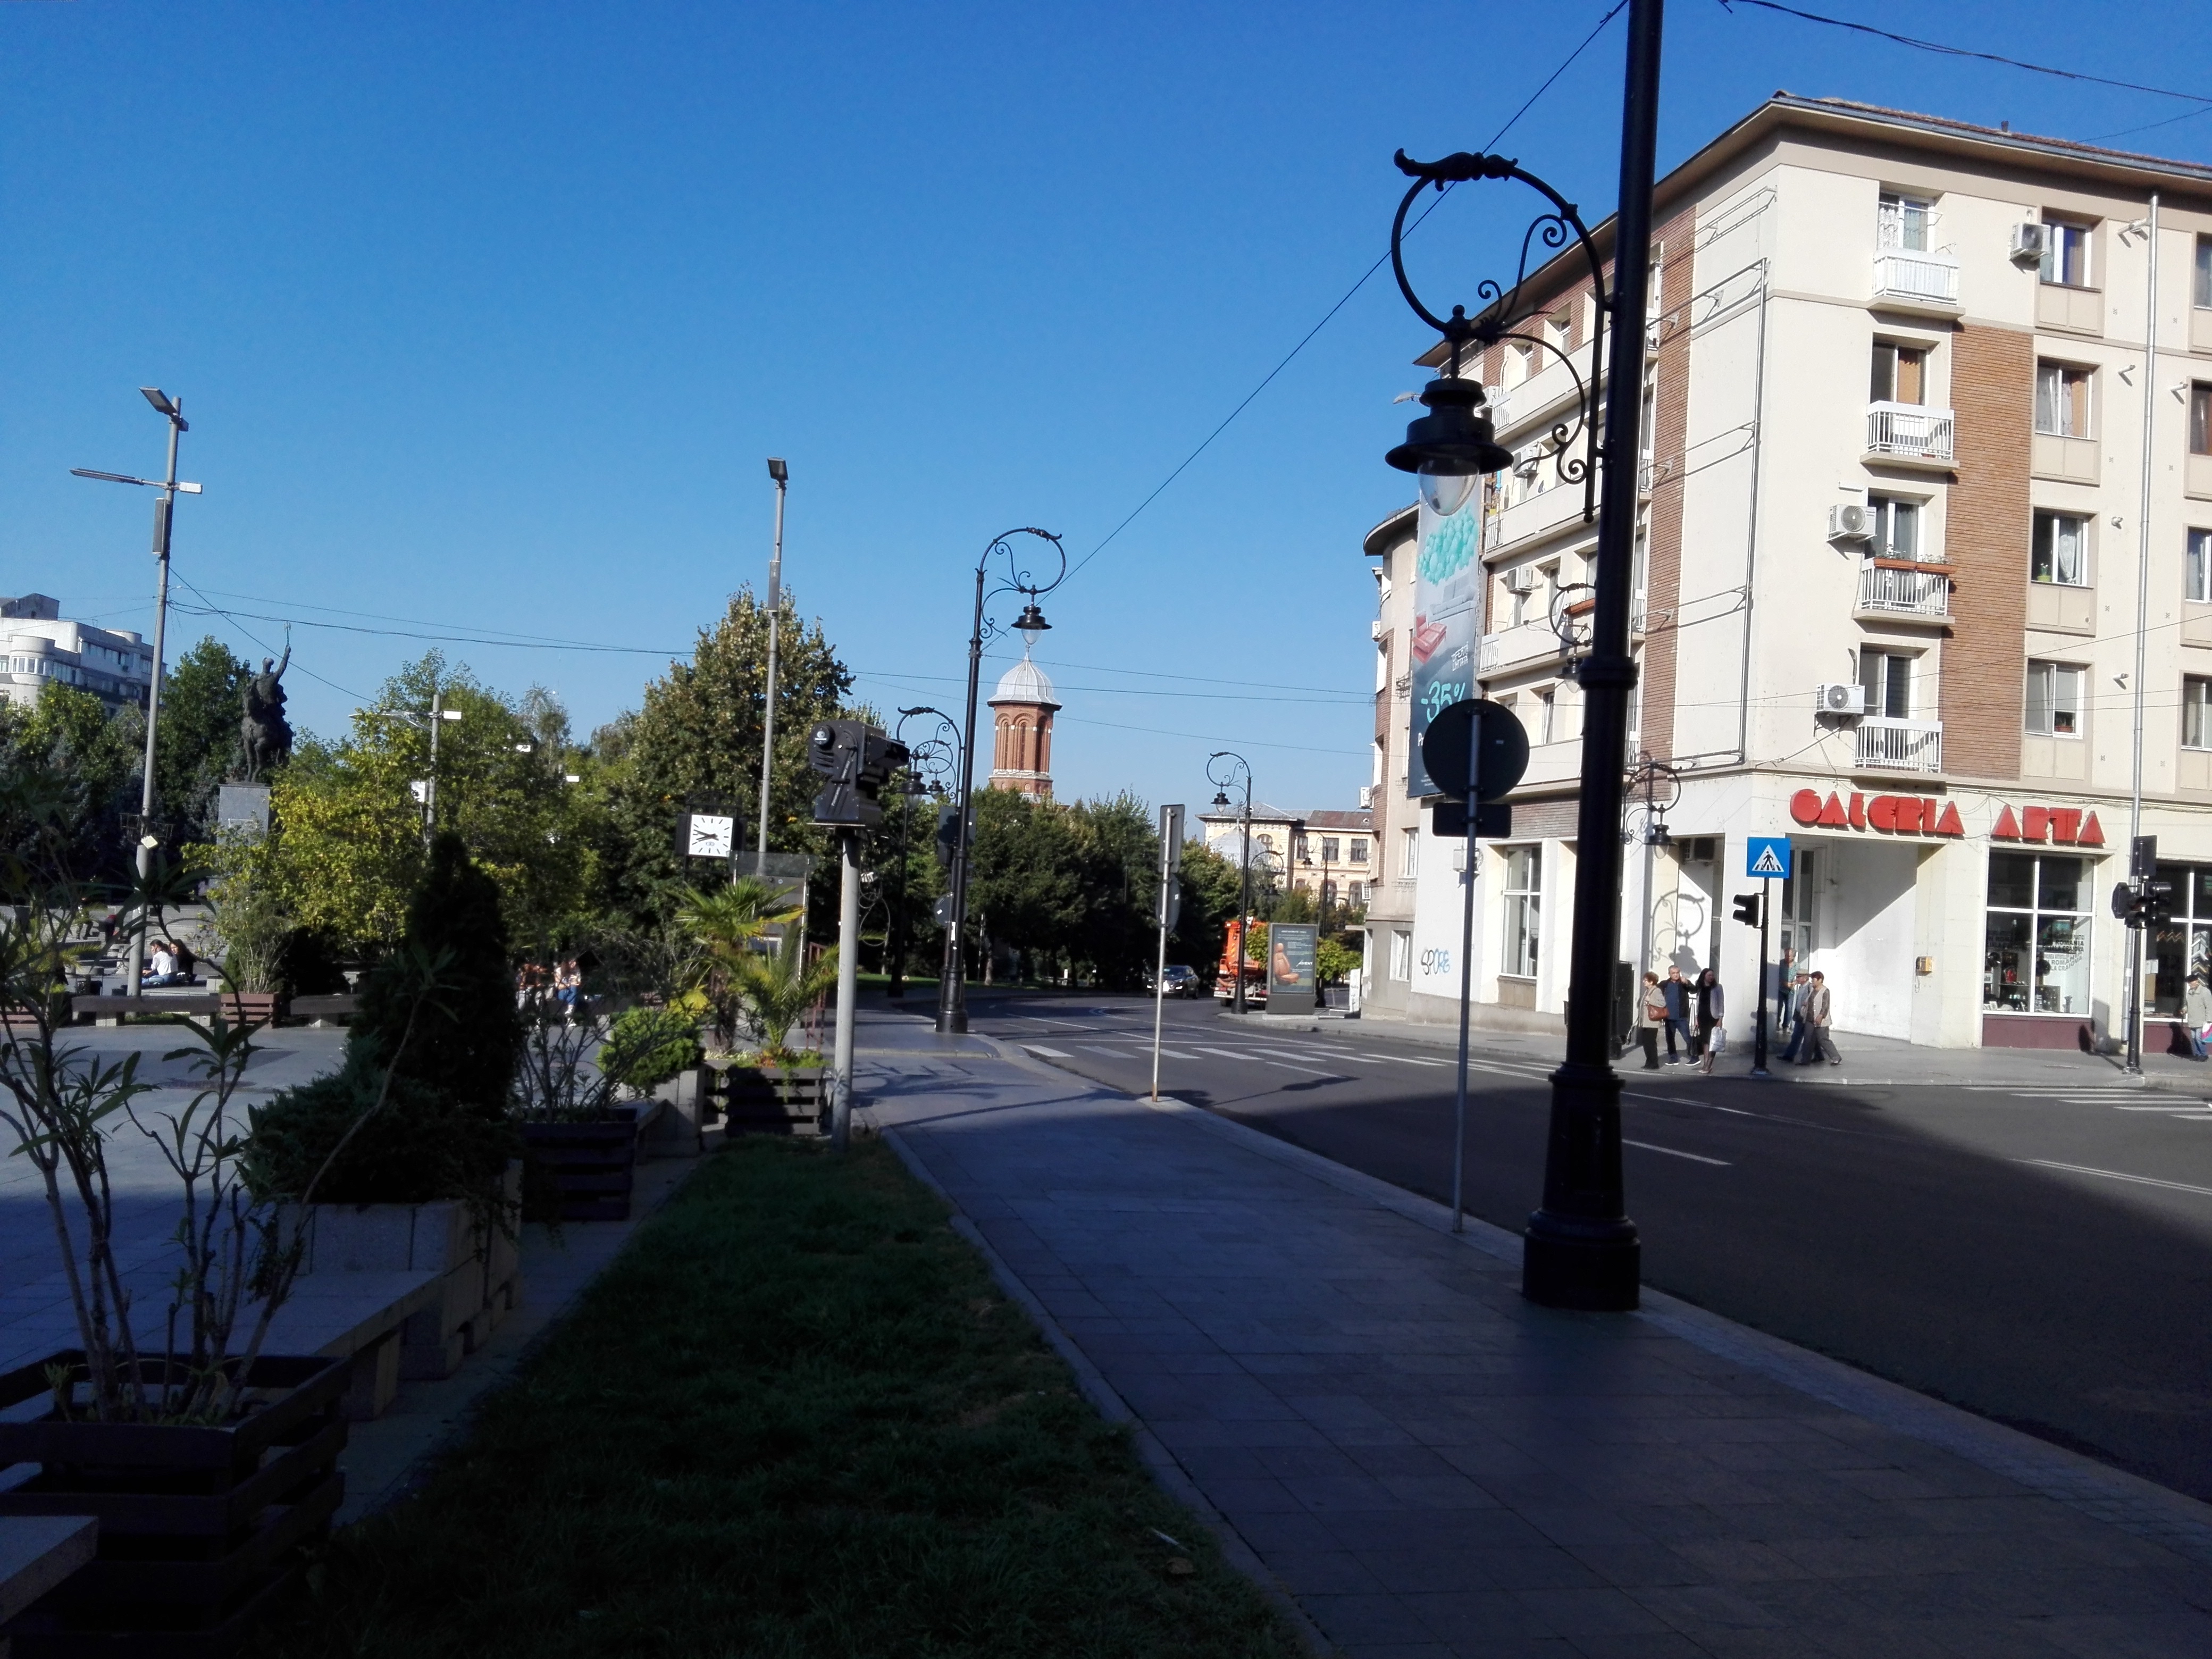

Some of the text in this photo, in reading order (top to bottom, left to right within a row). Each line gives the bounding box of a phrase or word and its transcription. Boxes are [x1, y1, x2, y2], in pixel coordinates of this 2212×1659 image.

[1421, 681, 1465, 723] -35%
[1790, 789, 2106, 847] GALERIA ARTA
